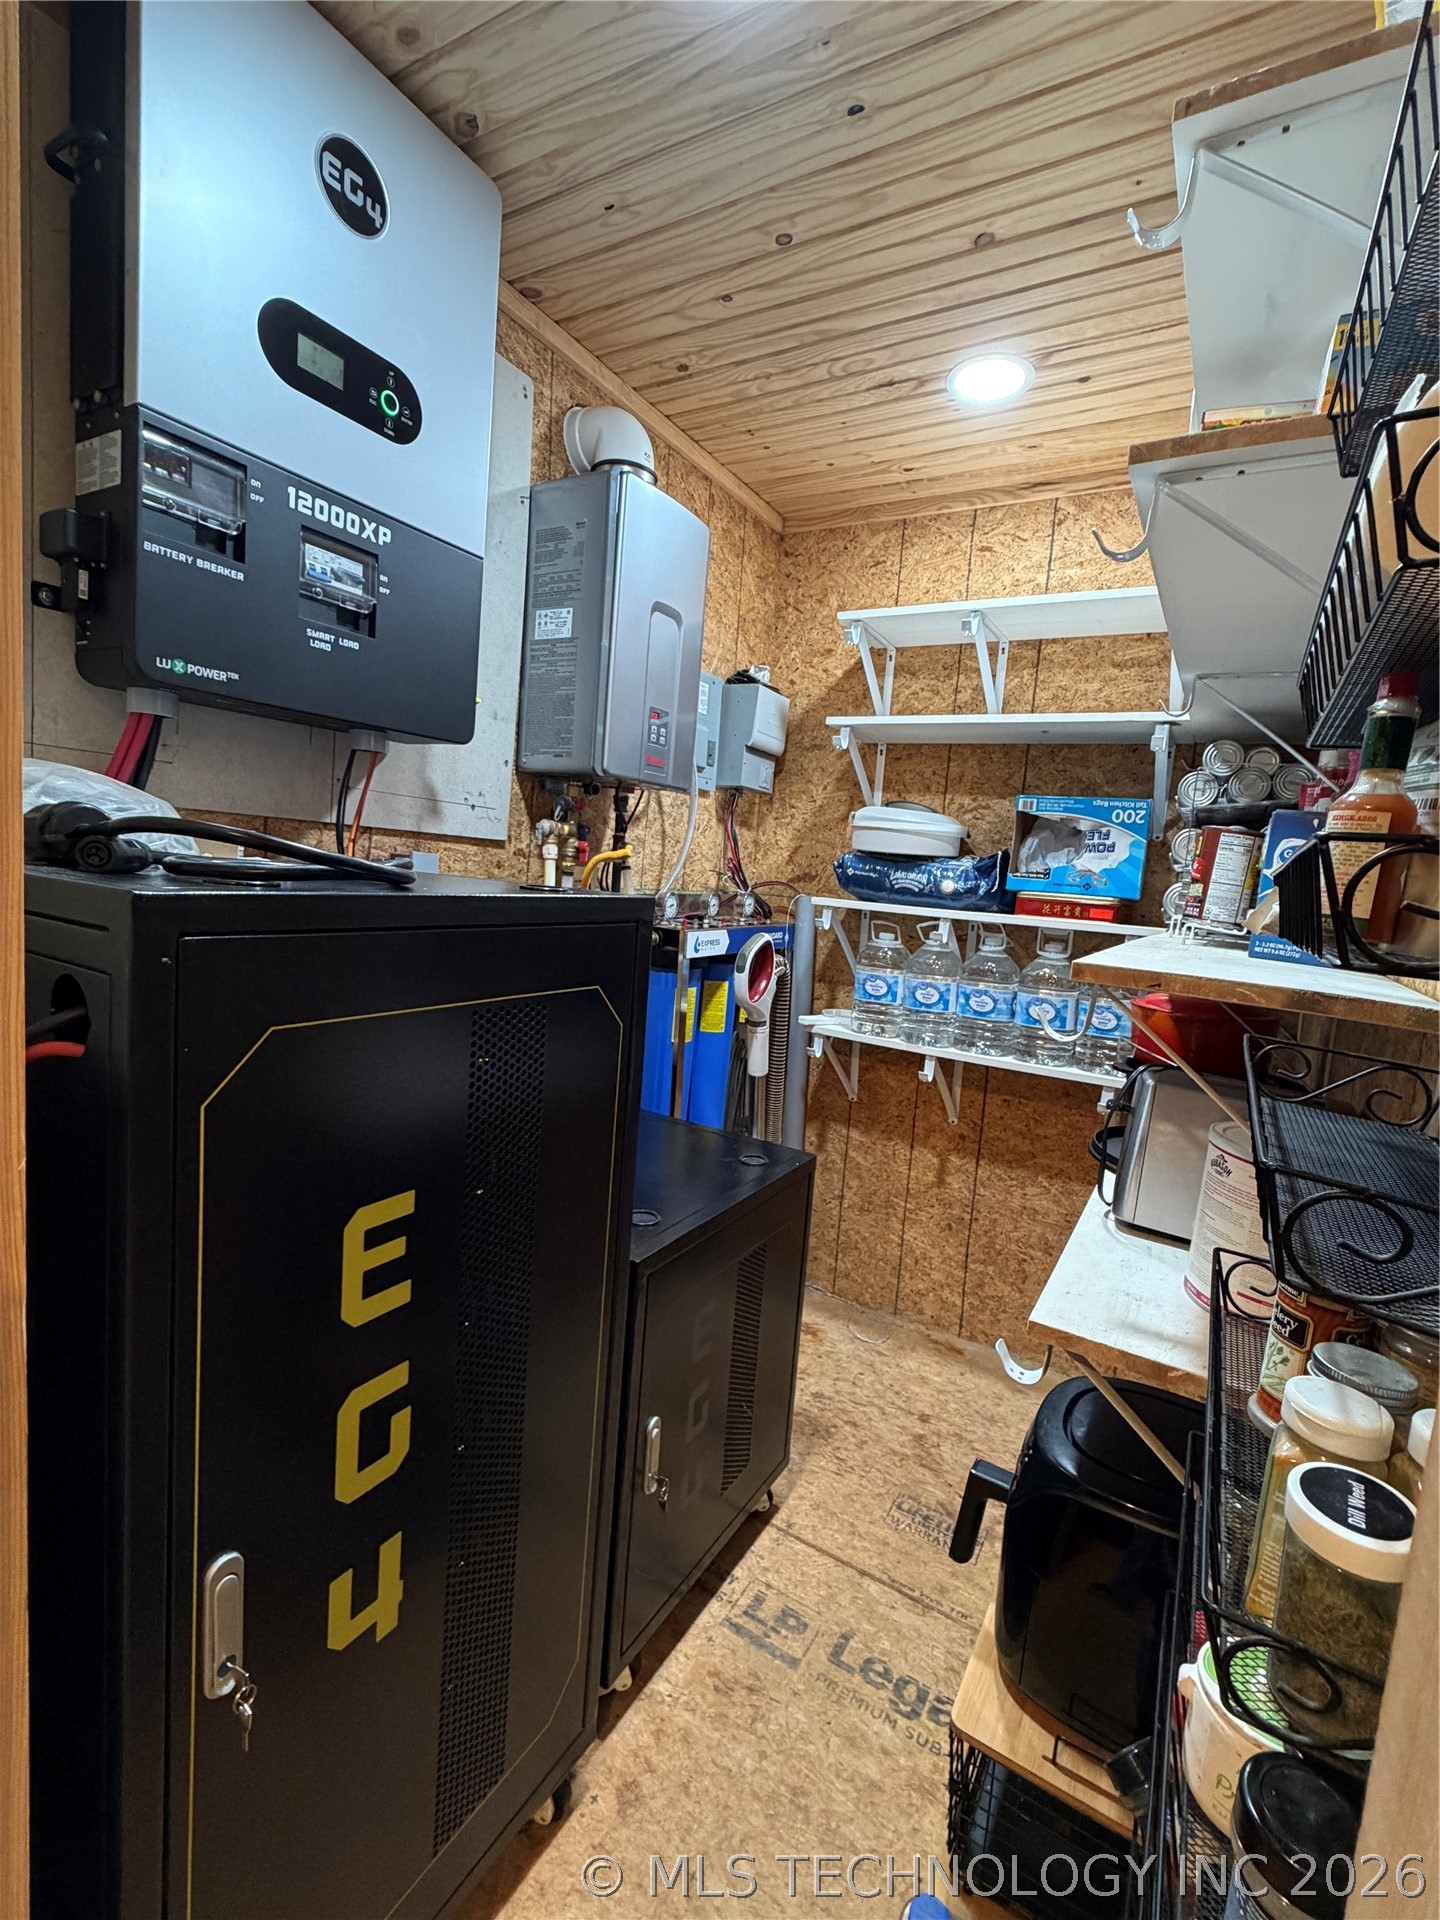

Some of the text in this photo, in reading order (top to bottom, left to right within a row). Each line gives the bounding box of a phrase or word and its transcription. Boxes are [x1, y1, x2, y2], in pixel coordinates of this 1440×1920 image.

[321, 150, 383, 229] EG4
[250, 479, 261, 489] ON
[250, 493, 264, 504] OFF
[287, 486, 392, 546] 12000XP
[143, 541, 245, 581] BATTERY BREAKER
[379, 586, 391, 596] OFF
[306, 628, 360, 650] SMART LOAD
[310, 640, 332, 652] LOAD
[1111, 809, 1147, 824] 200
[1087, 829, 1111, 840] FLE
[701, 939, 721, 947] EXPRESS
[327, 1190, 416, 1651] EG4
[1347, 1480, 1366, 1530] Dill Weed
[743, 1588, 810, 1636] LP
[827, 1629, 956, 1729] Lega
[814, 1673, 899, 1731] PREMIUM
